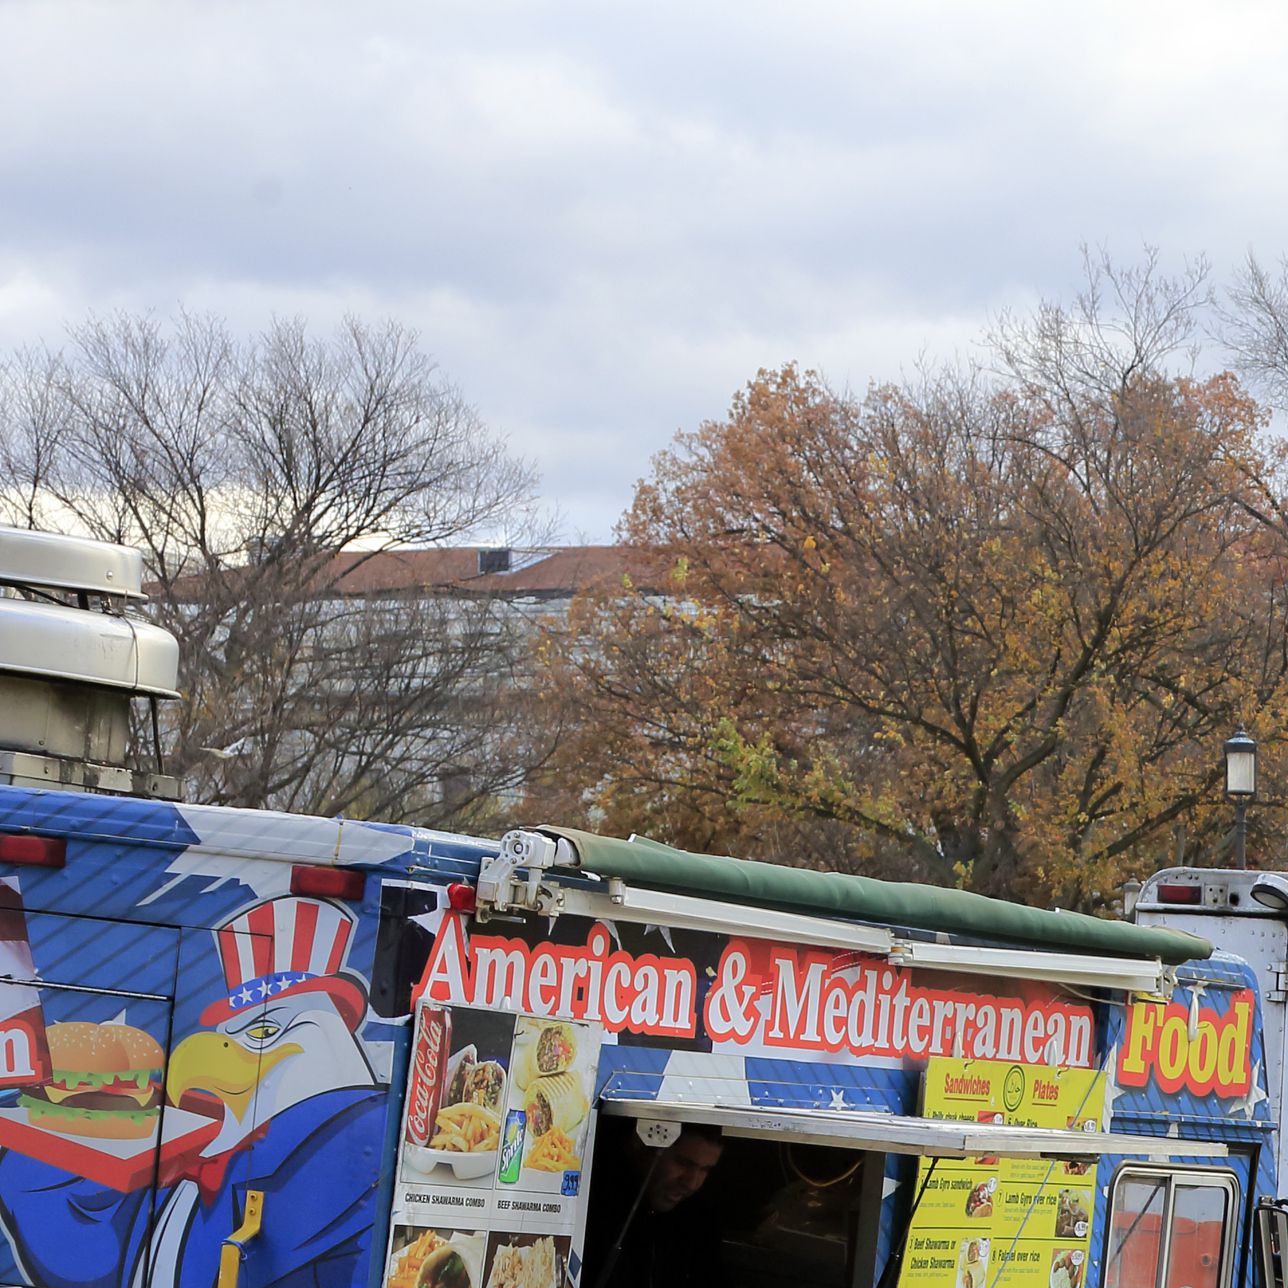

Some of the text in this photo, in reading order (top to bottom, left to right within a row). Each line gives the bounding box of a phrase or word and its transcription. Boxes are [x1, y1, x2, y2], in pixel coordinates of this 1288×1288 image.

[418, 916, 1249, 1086] American & Mediterranean Food
[944, 1072, 991, 1096] Sandwiches
[1032, 1079, 1060, 1101] Plates
[939, 1178, 950, 1191] Gyro
[951, 1180, 973, 1191] sandwich
[405, 1192, 485, 1208] CHICKEN SHAWARMA COMBO
[1005, 1192, 1057, 1206] Lamb Gyro rice
[497, 1200, 562, 1214] BEEF SHAWARMA COMBO
[914, 1238, 957, 1250] Beef Shawarma or
[1018, 1250, 1041, 1262] over rice
[910, 1257, 955, 1270] Chicken Shawarma
